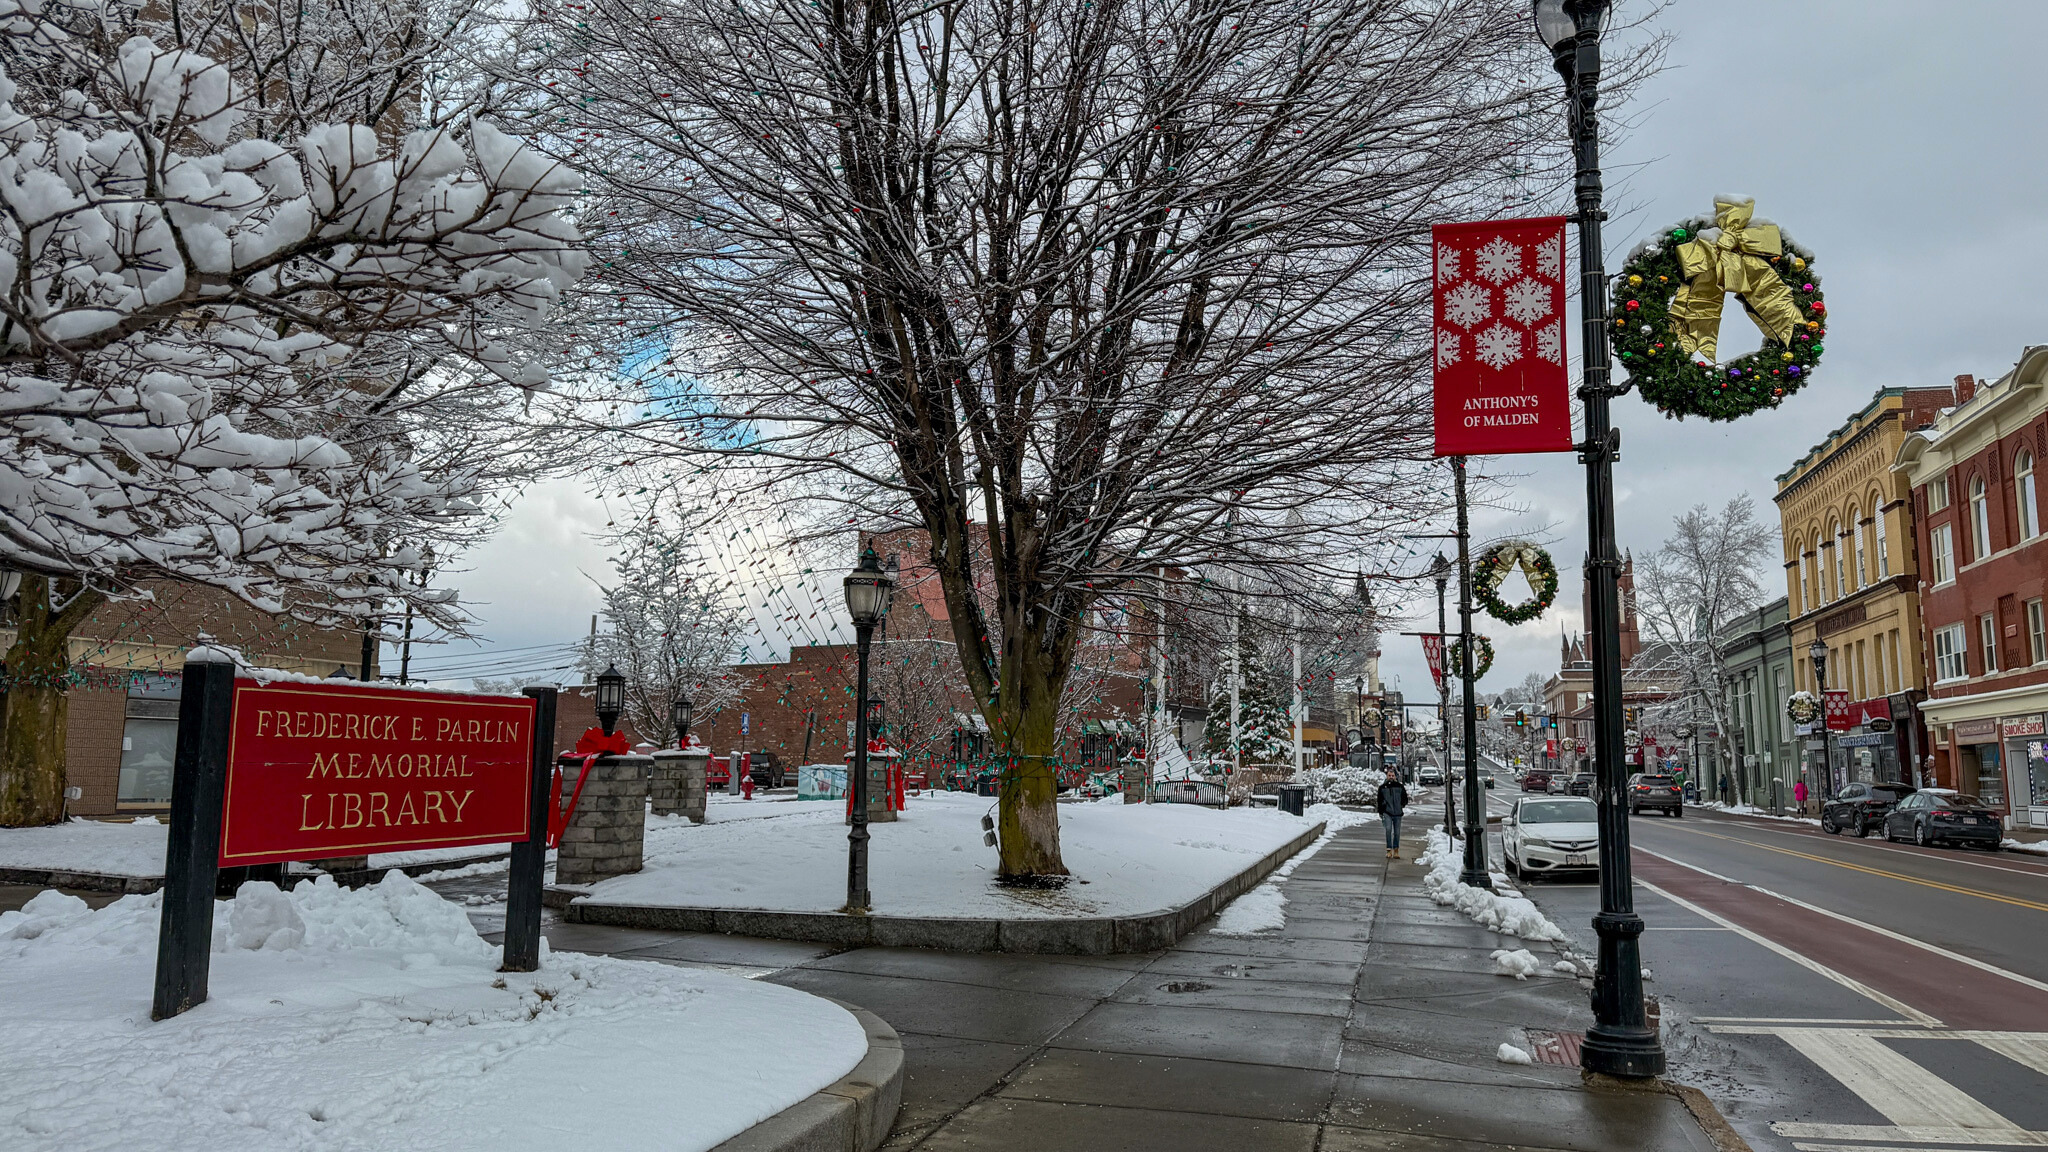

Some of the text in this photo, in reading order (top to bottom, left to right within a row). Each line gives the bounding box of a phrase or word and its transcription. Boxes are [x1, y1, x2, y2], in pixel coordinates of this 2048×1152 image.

[1463, 394, 1539, 410] ANTHONY'S
[1463, 412, 1539, 428] OF MALDEN
[256, 710, 519, 743] FREDERICK E. PARLIN
[2004, 723, 2026, 736] SMOKE
[2026, 721, 2043, 734] SHOP
[306, 752, 474, 779] MEMORIAL
[298, 789, 474, 831] LIBRARY
